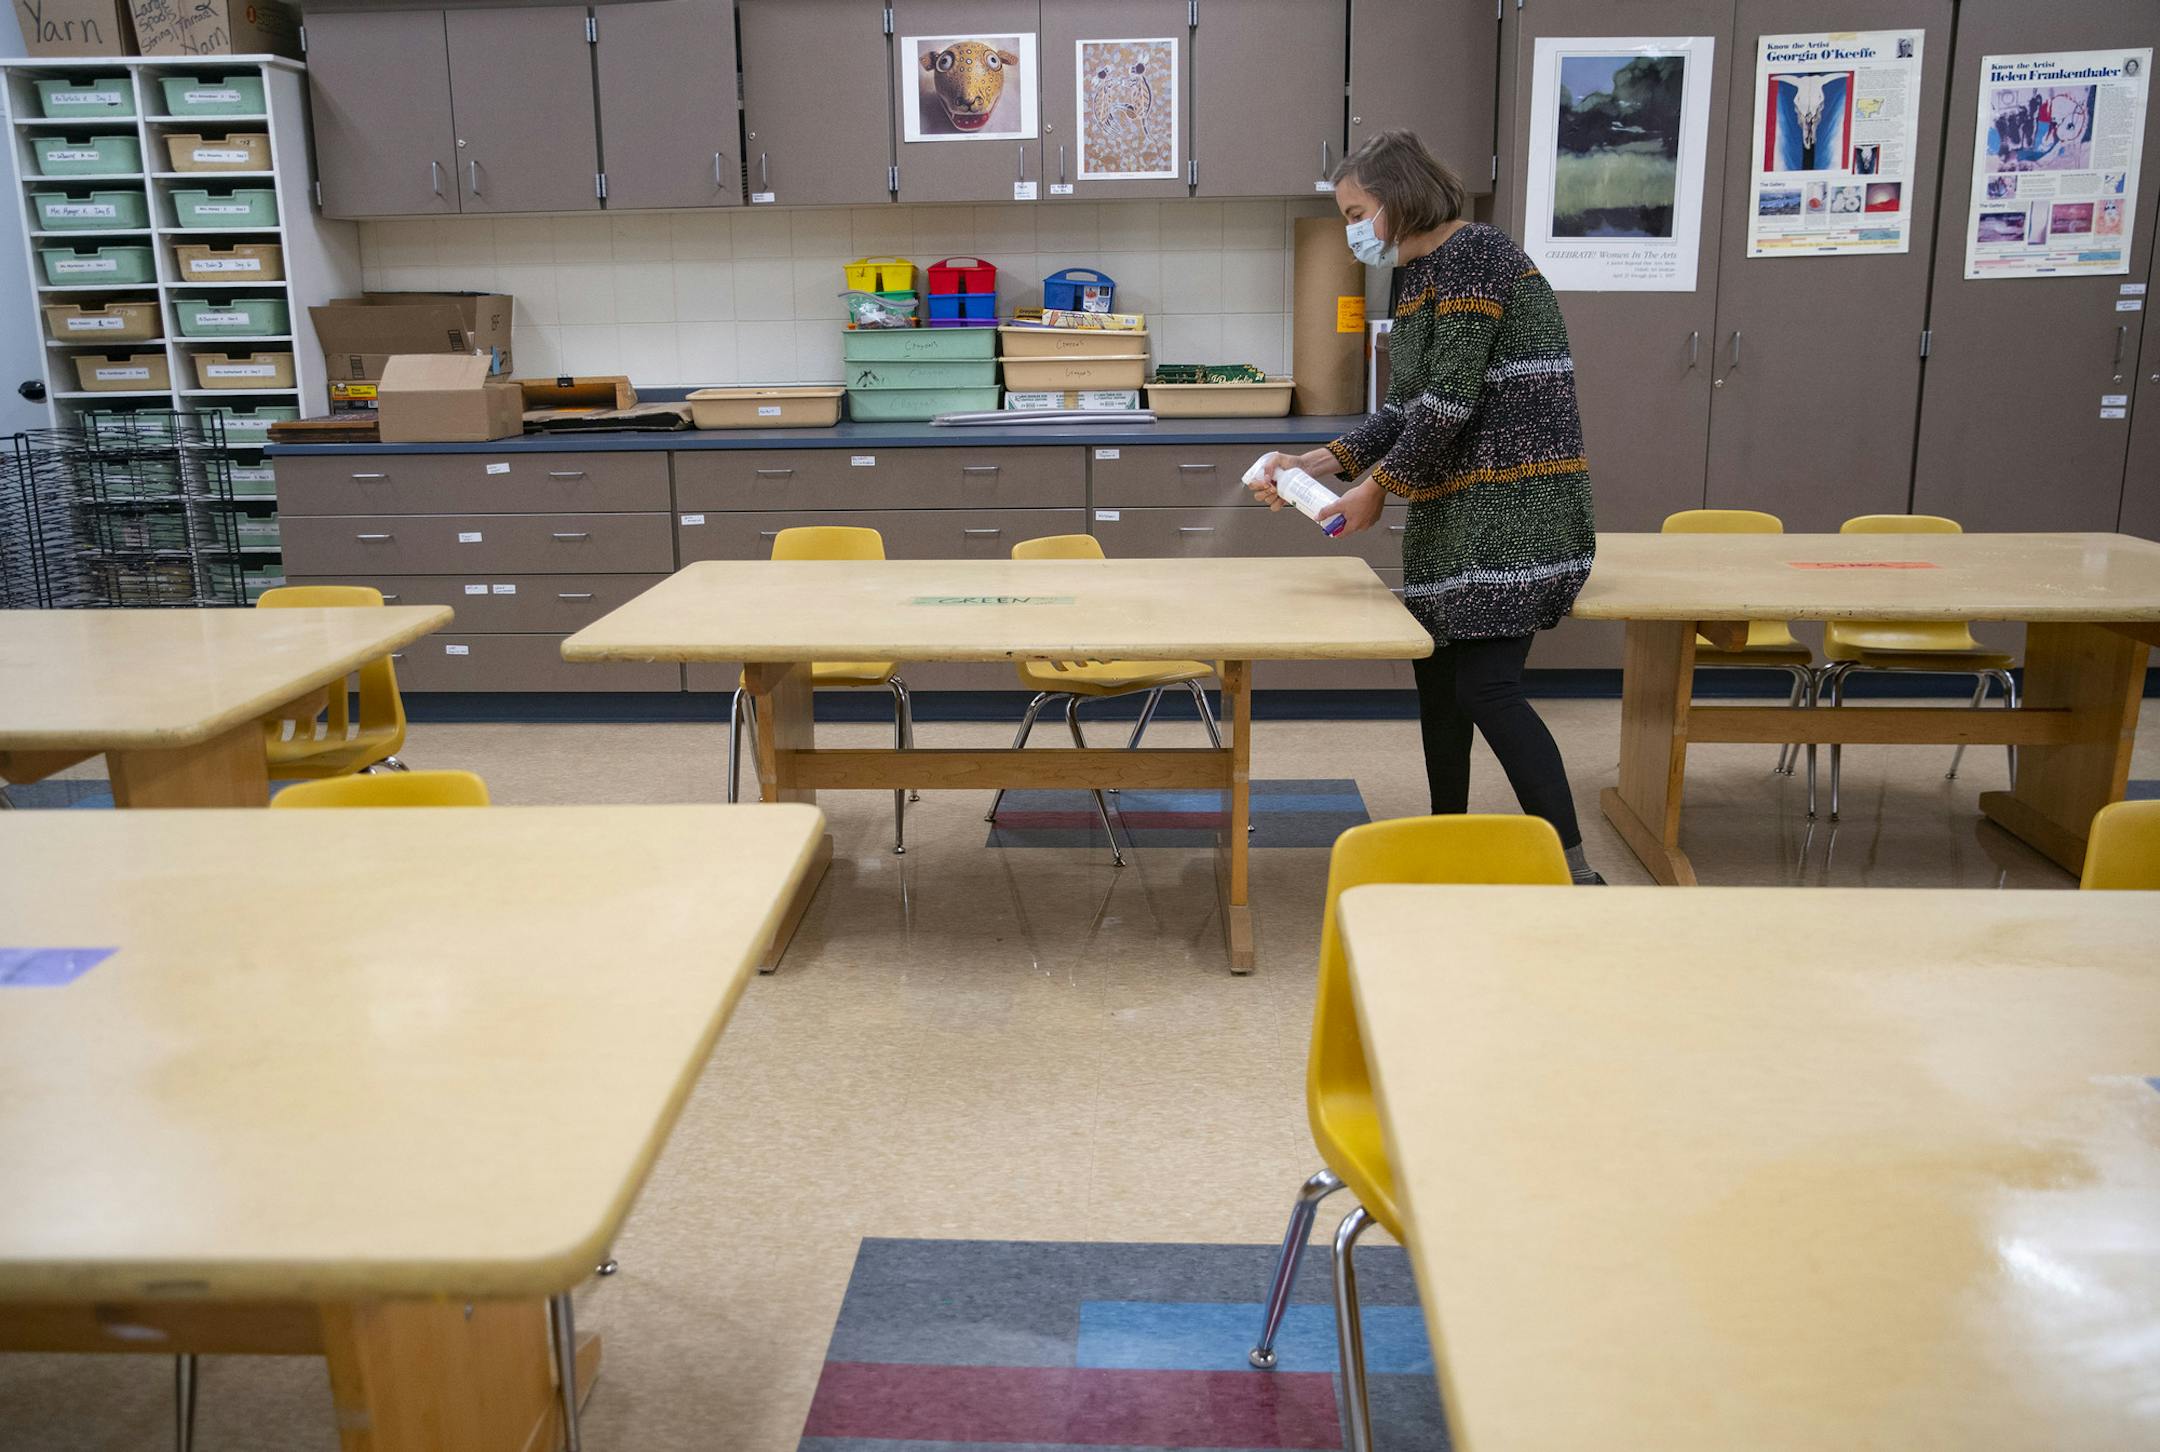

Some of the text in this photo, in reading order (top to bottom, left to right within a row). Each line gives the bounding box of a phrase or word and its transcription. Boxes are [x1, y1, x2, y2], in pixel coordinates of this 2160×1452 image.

[23, 0, 103, 44] Yarn
[180, 26, 229, 55] Yarn
[1766, 48, 1876, 63] Georgia O'Keeffe
[1991, 67, 2121, 82] Helen Frankenthaler
[1599, 251, 1630, 259] Women
[1632, 251, 1641, 259] In
[1644, 250, 1659, 259] The
[1660, 251, 1677, 259] Arts
[938, 597, 1032, 605] GREEN
